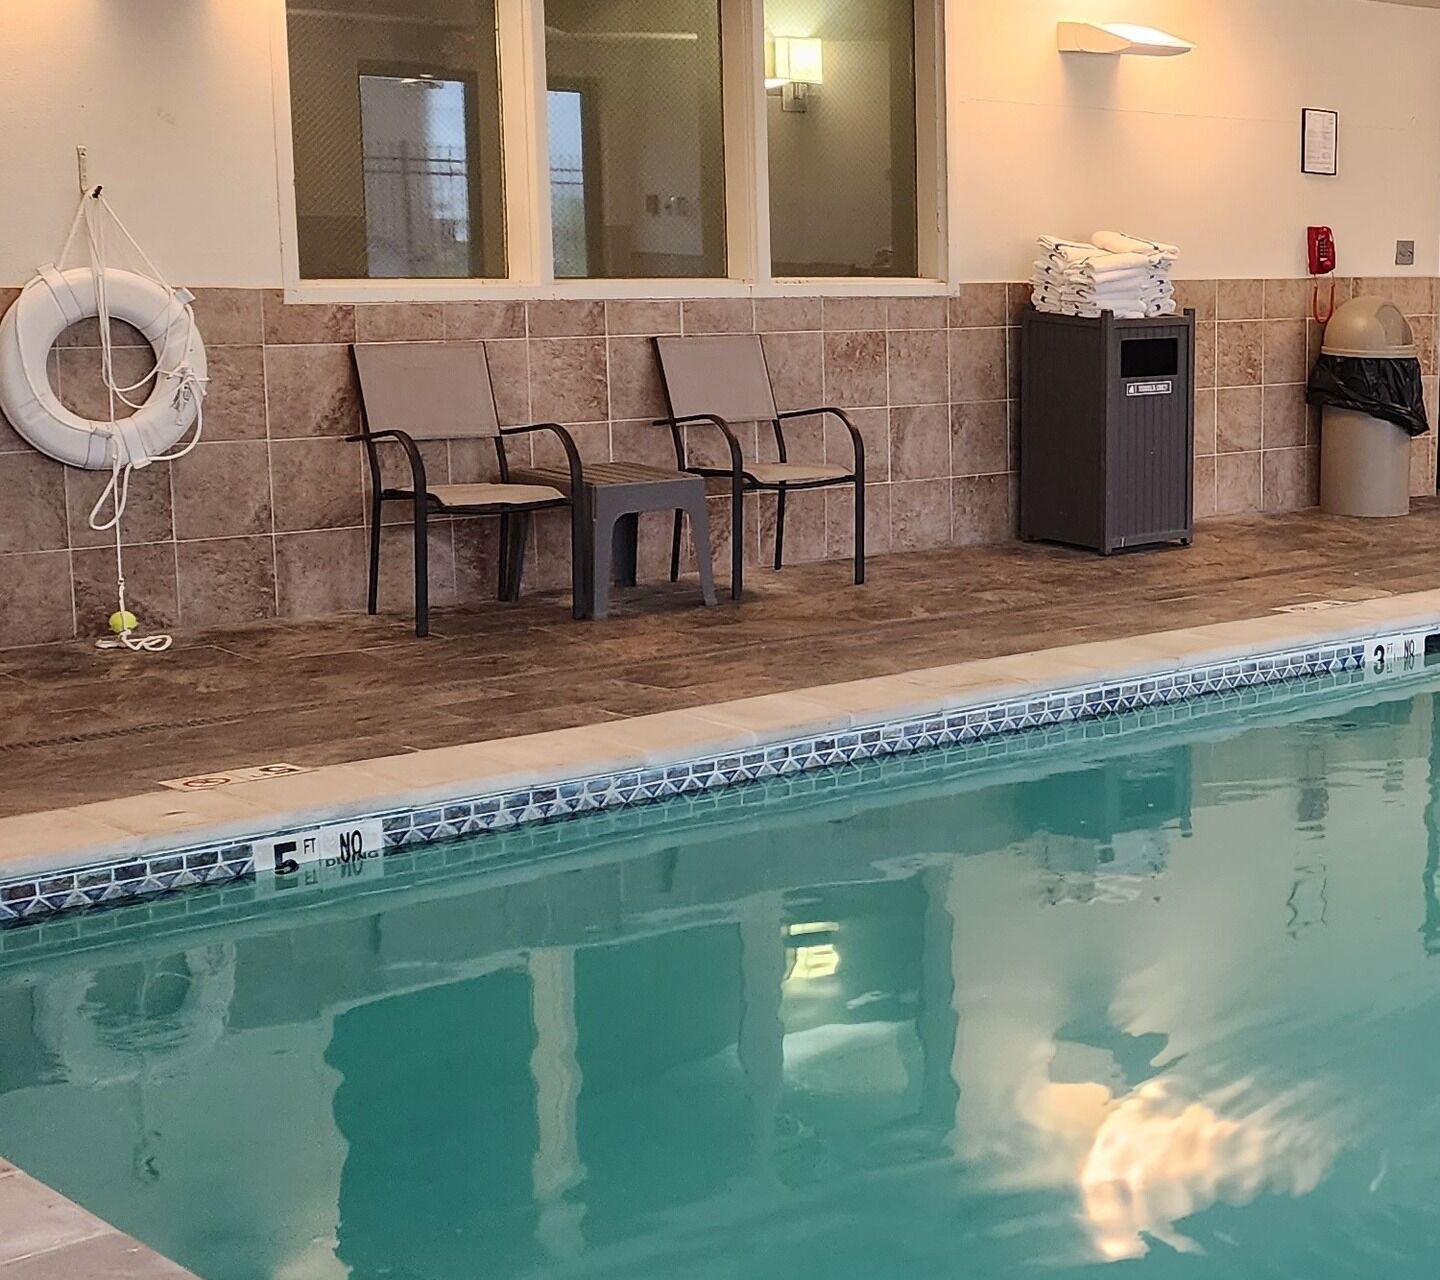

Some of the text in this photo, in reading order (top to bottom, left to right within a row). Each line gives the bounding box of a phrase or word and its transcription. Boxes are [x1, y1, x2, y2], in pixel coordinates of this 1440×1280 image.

[273, 837, 316, 875] 5 FT
[340, 830, 362, 863] NO
